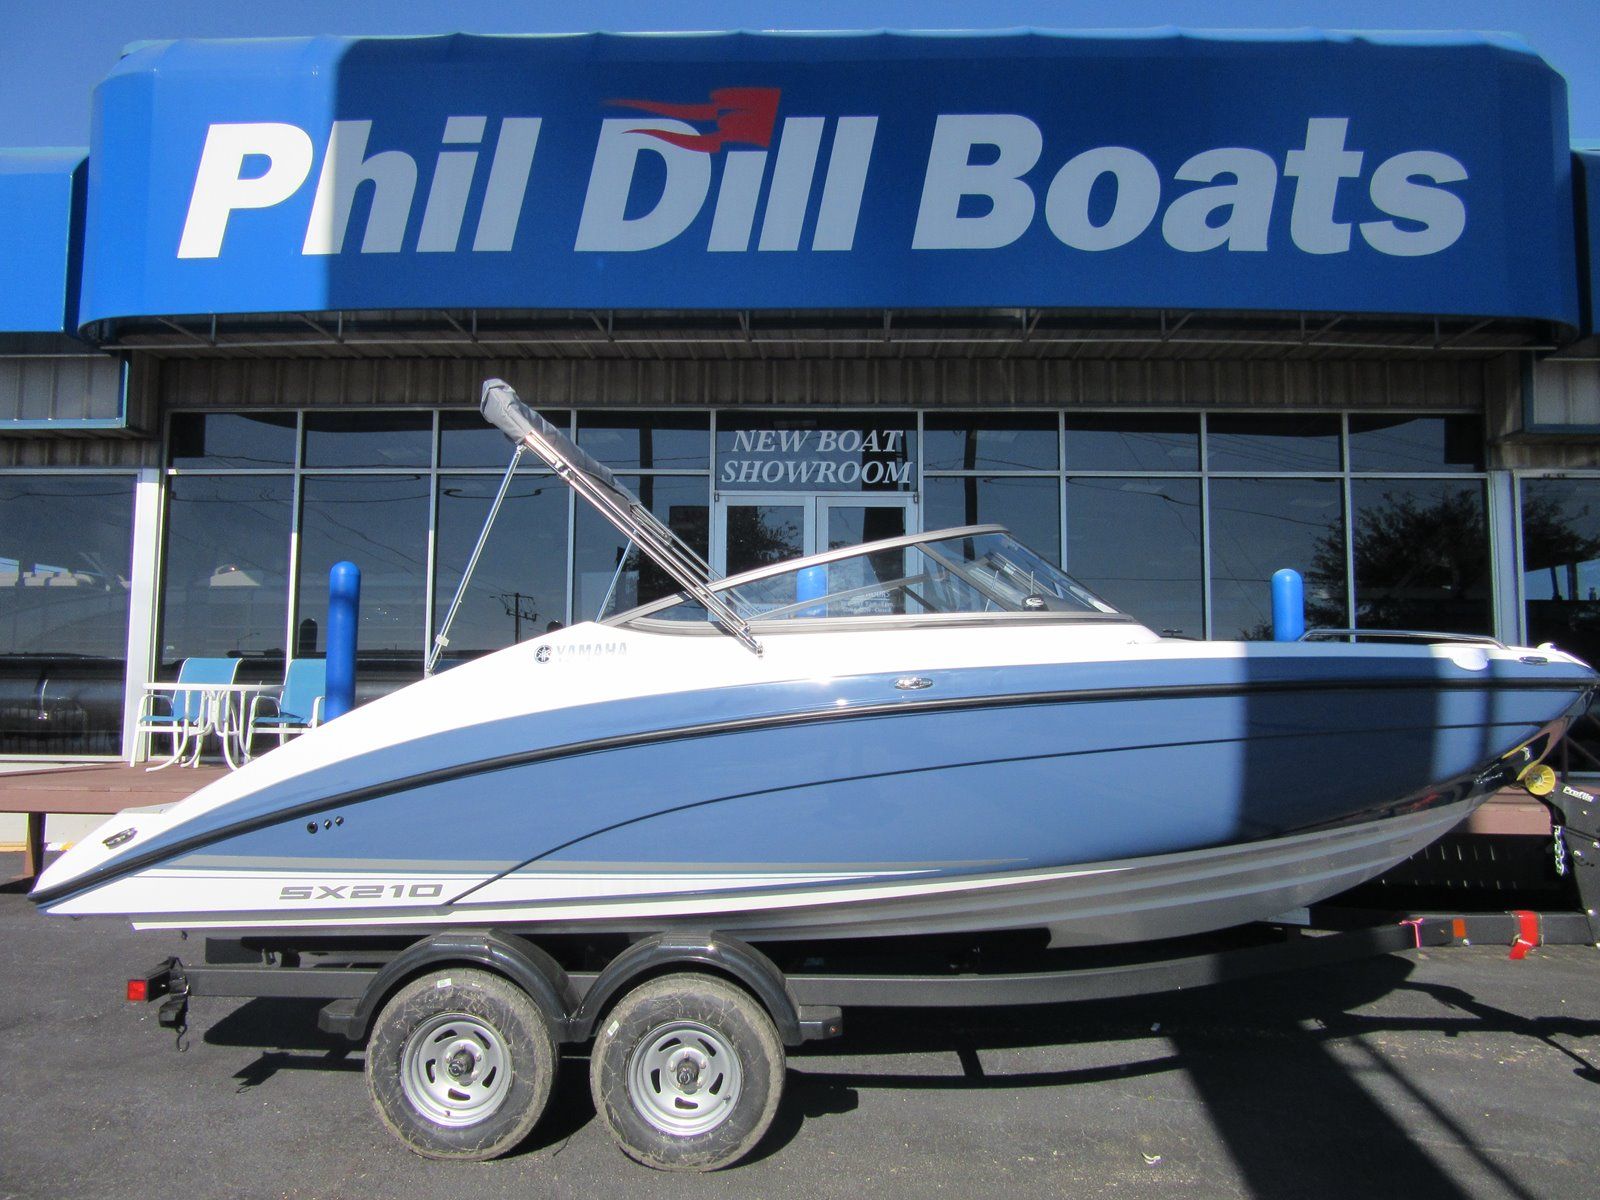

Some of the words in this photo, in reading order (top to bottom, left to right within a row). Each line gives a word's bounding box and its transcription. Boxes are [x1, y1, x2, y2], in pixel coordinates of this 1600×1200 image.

[176, 115, 543, 260] Phil
[573, 115, 879, 253] Dill
[911, 114, 1469, 257] Boats
[732, 430, 812, 452] NEW
[815, 430, 904, 452] BOAT
[721, 460, 913, 484] SHOWROOM
[556, 642, 628, 656] YAMAHA
[279, 884, 444, 900] SX210
